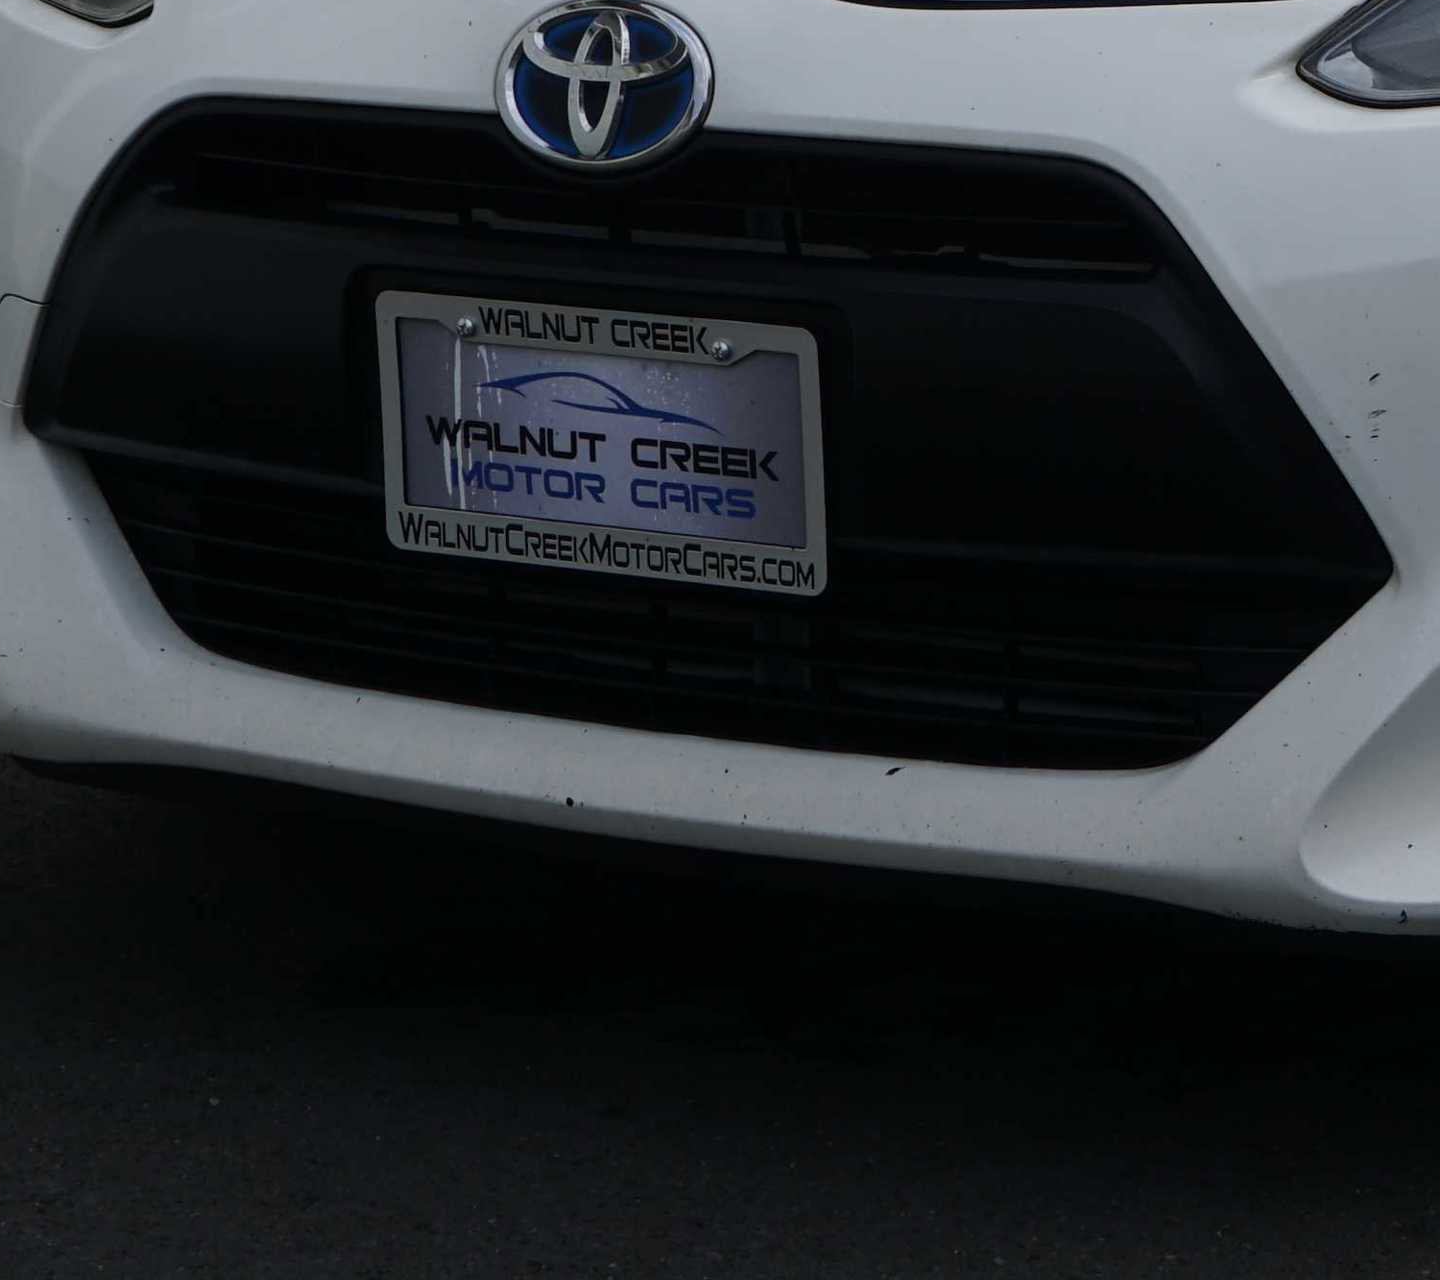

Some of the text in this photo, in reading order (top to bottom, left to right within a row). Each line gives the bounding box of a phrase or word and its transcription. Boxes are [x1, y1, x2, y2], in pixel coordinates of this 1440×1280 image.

[478, 305, 710, 356] WALNUT CREEK
[426, 414, 780, 482] WALNUT CREEK
[451, 458, 758, 520] MOTOR CARS
